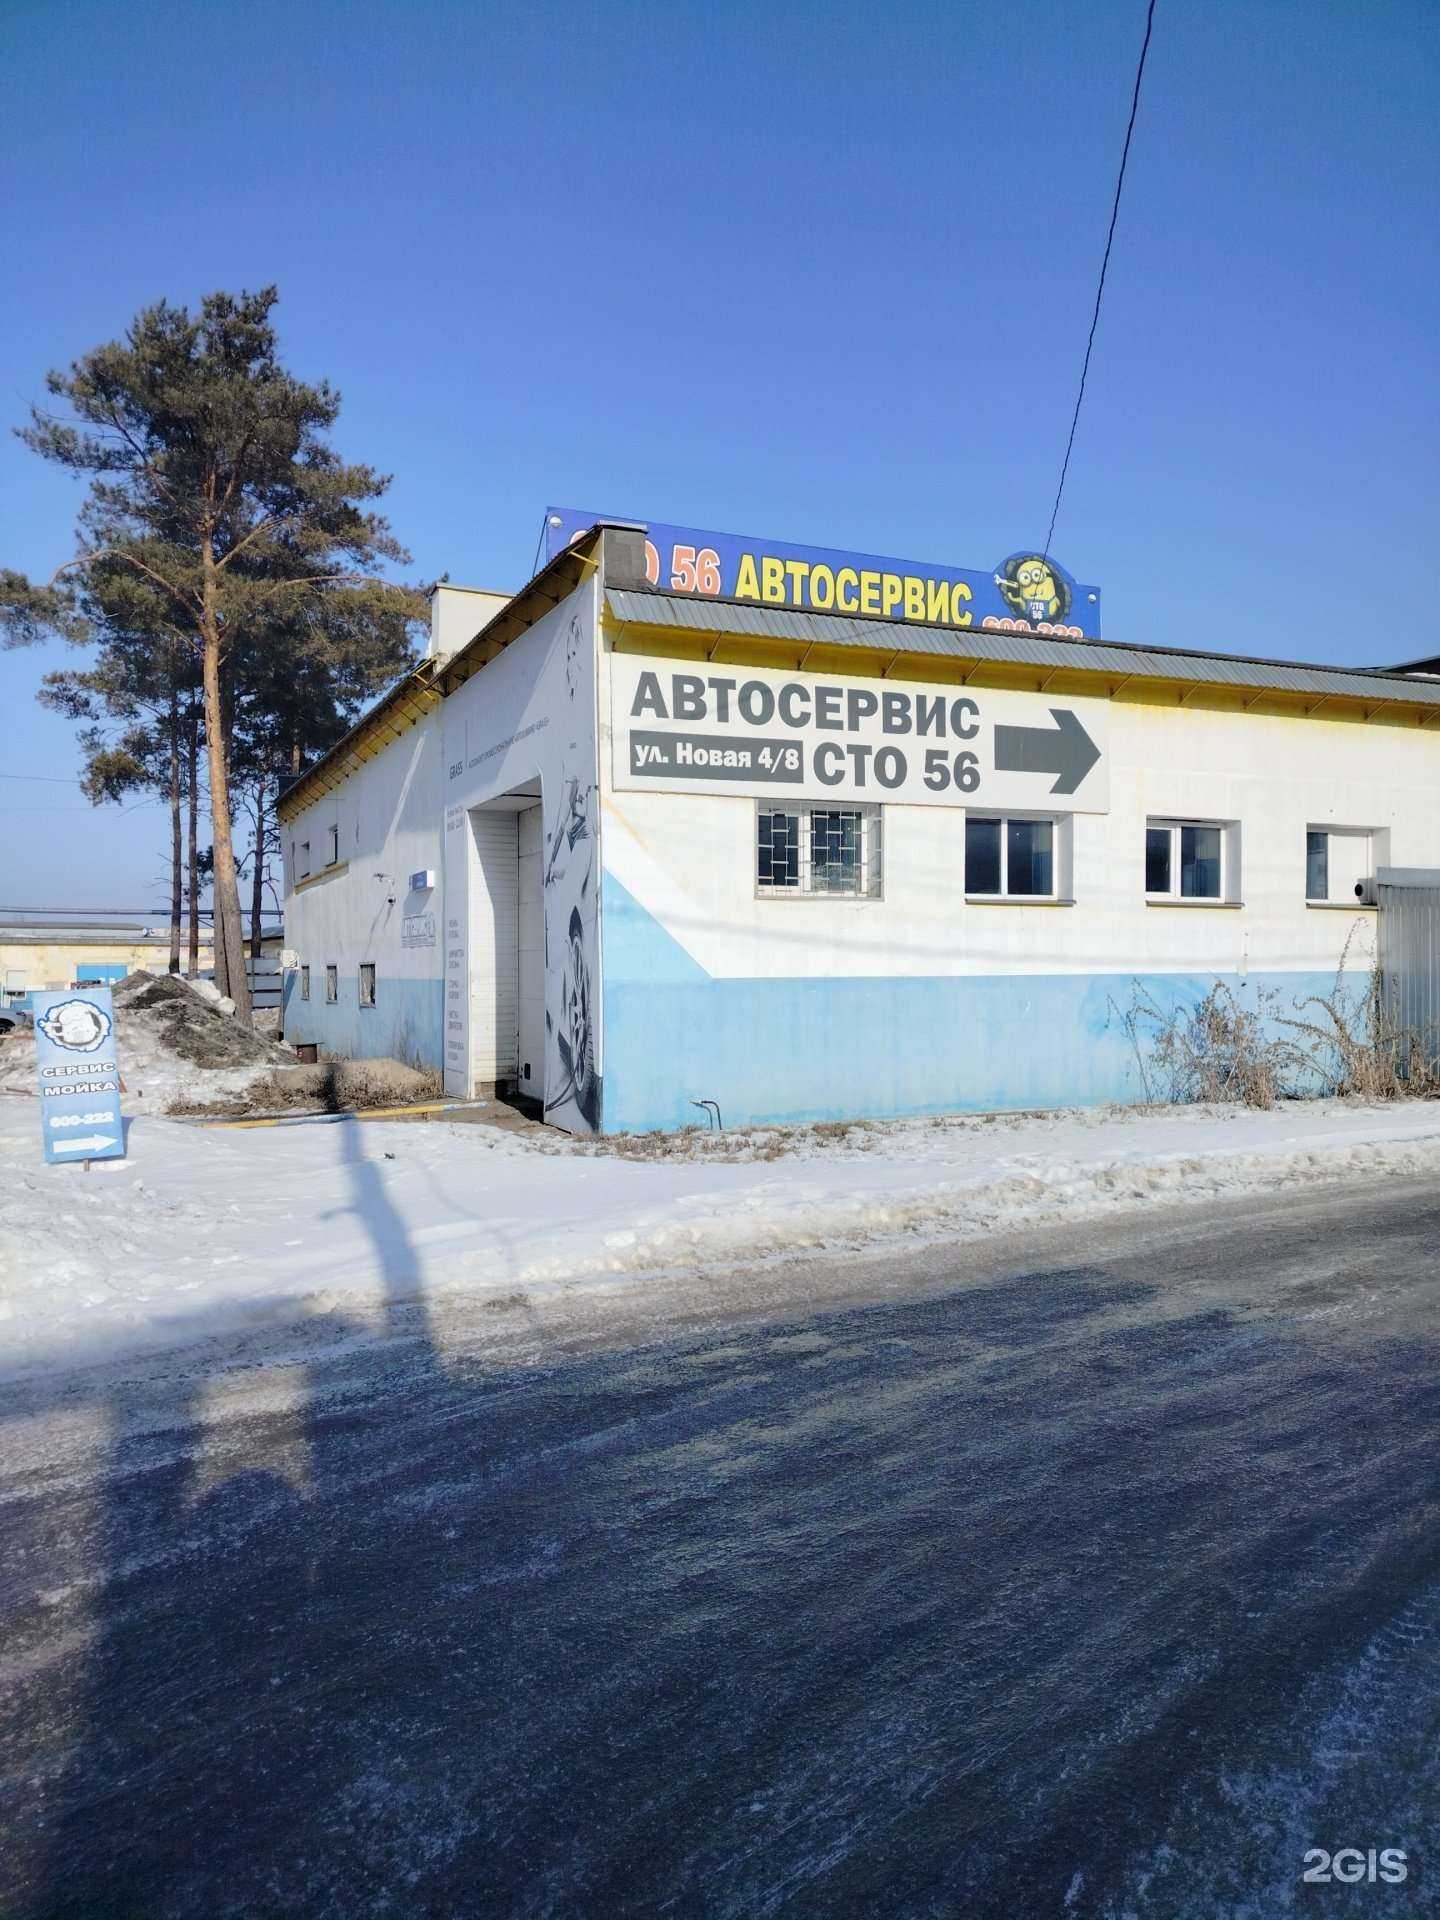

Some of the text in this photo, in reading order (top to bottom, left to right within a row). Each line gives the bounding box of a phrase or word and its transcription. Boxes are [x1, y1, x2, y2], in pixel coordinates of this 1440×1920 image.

[671, 544, 721, 595] 56
[735, 554, 973, 627] АВТОСЕРВИС
[630, 671, 980, 740] АВТОСЕРВИС
[635, 742, 800, 774] ул. Новая 4/8
[813, 742, 981, 793] СТО 56
[42, 1063, 115, 1078] СЕРВИС
[44, 1080, 117, 1096] МОЙКА
